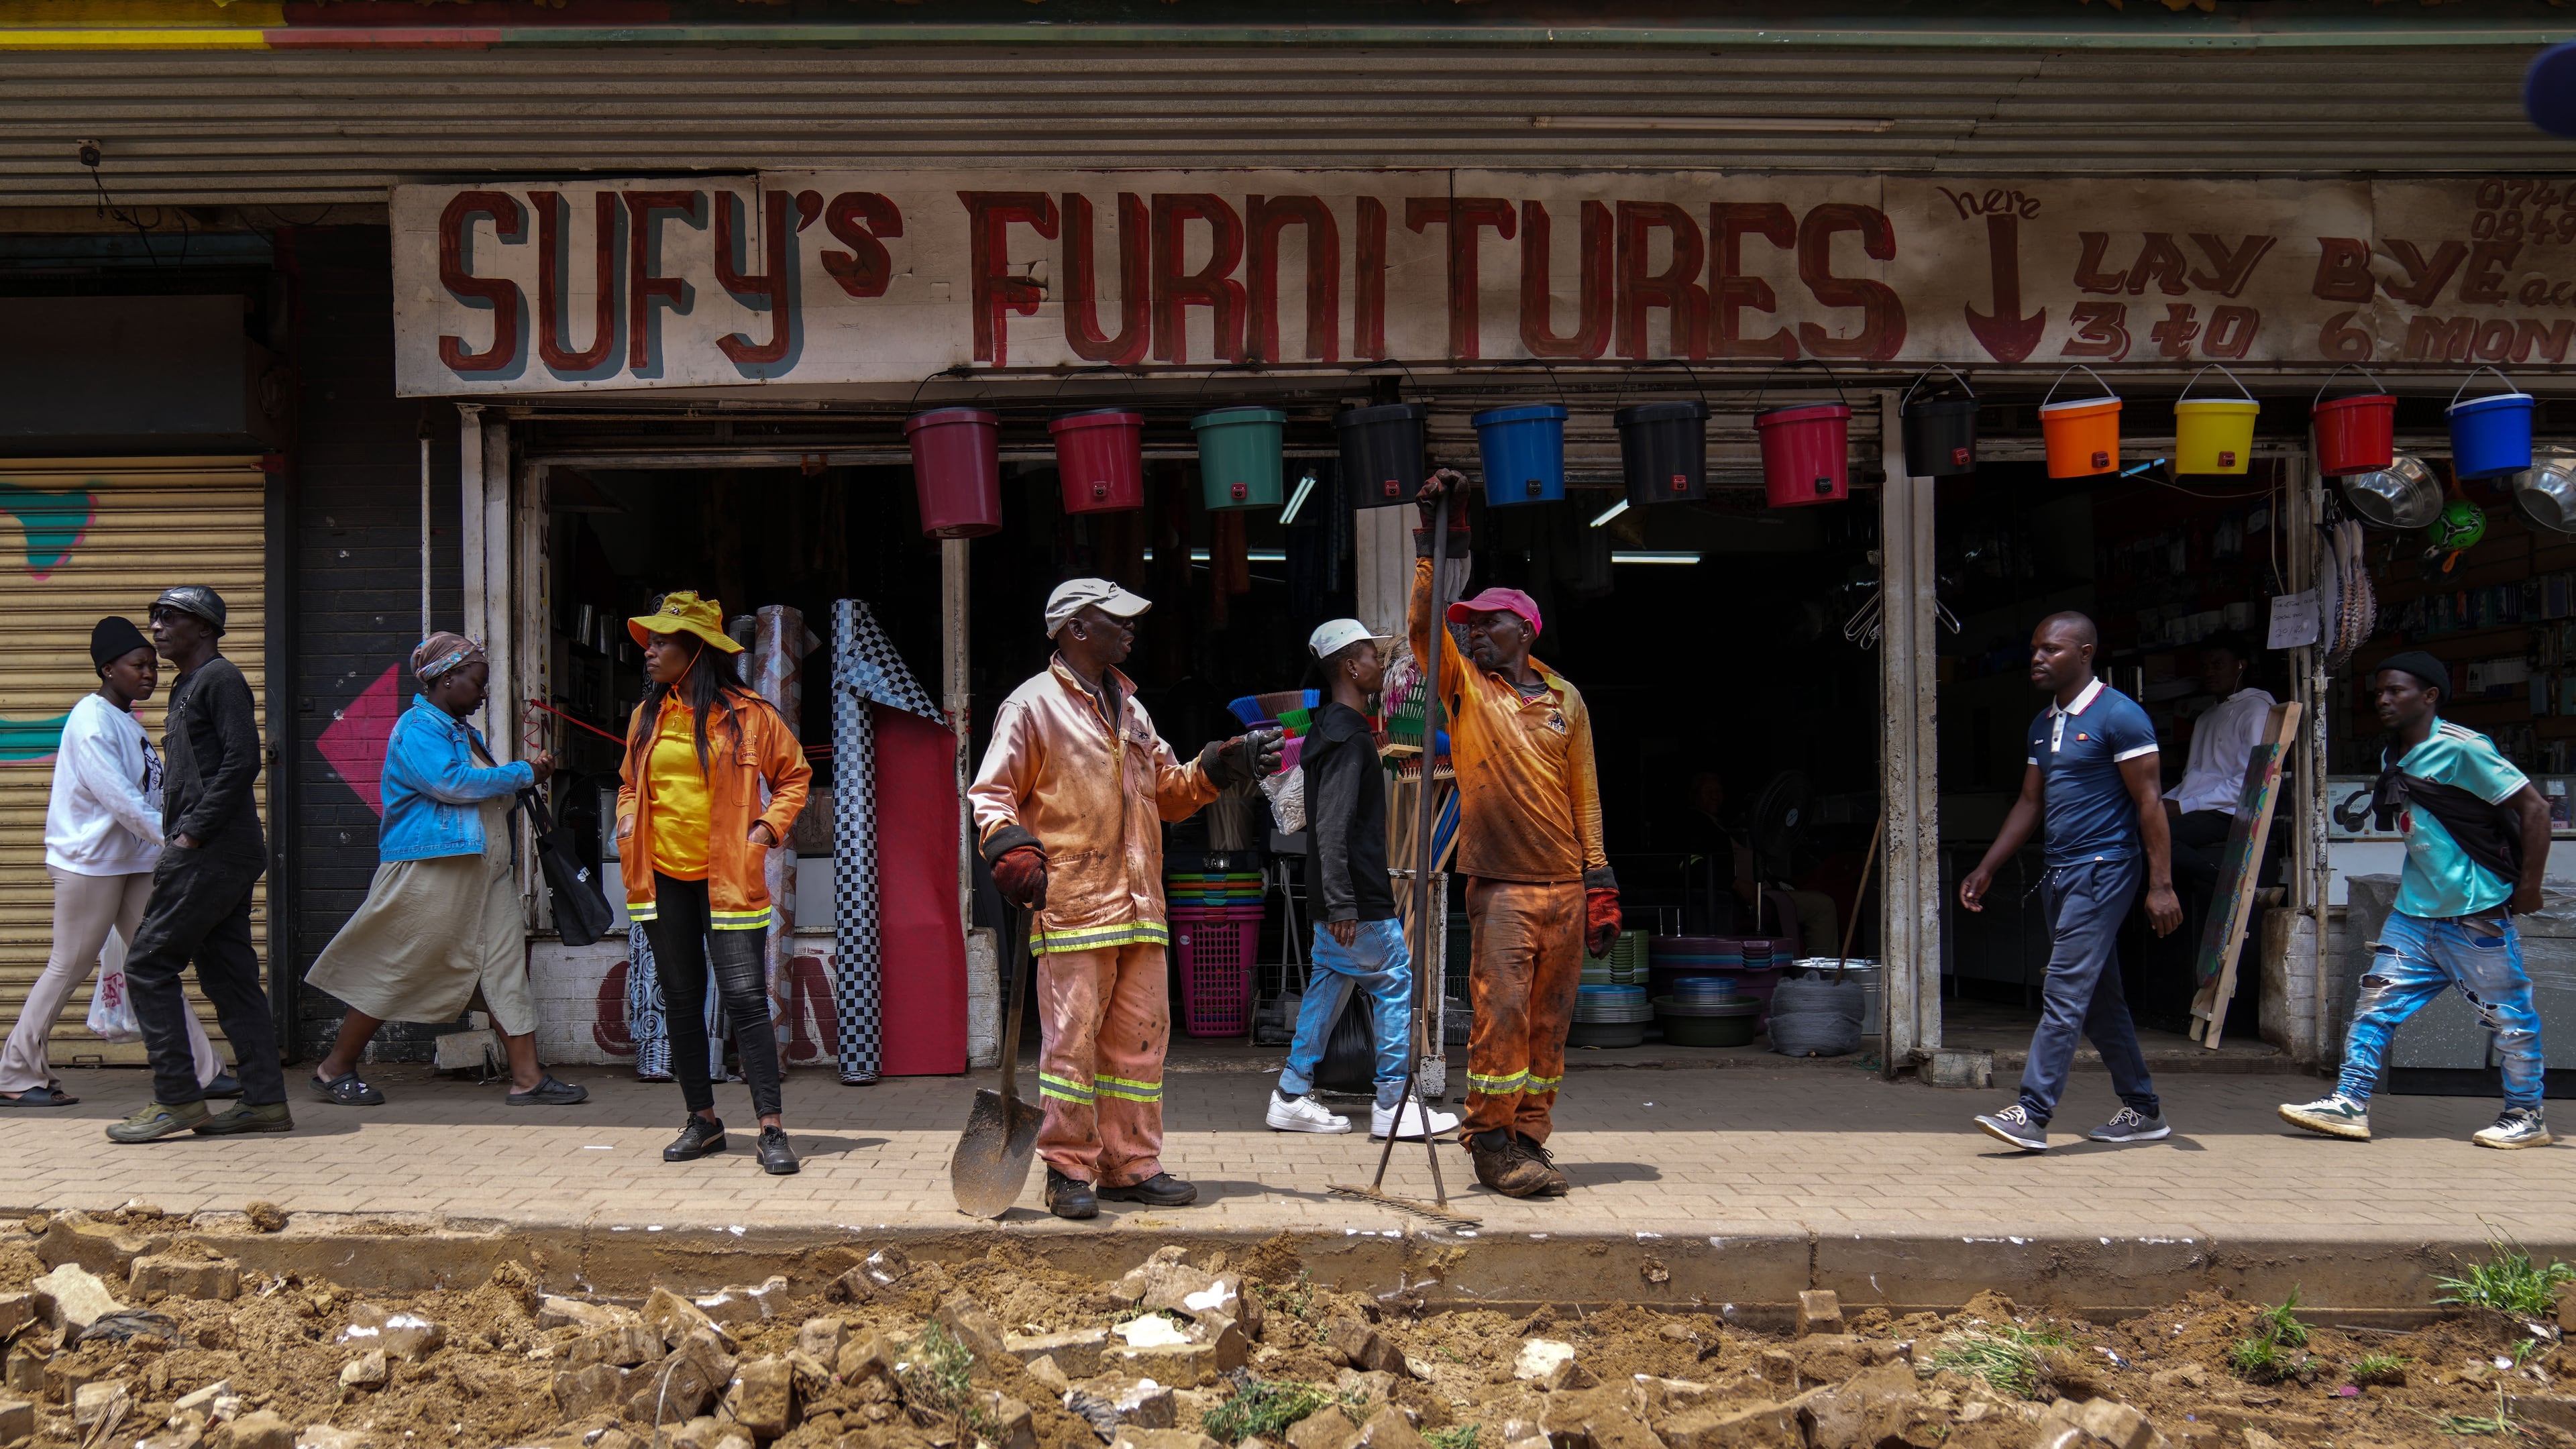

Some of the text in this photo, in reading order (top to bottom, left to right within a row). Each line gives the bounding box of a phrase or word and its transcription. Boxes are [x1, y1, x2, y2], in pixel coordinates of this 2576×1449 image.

[1935, 186, 2041, 220] here
[957, 191, 1907, 367] FURNITURES
[2074, 231, 2524, 308] LAY BYE
[2518, 278, 2576, 307] ac
[2059, 301, 2131, 362] 3
[2318, 310, 2373, 362] 6
